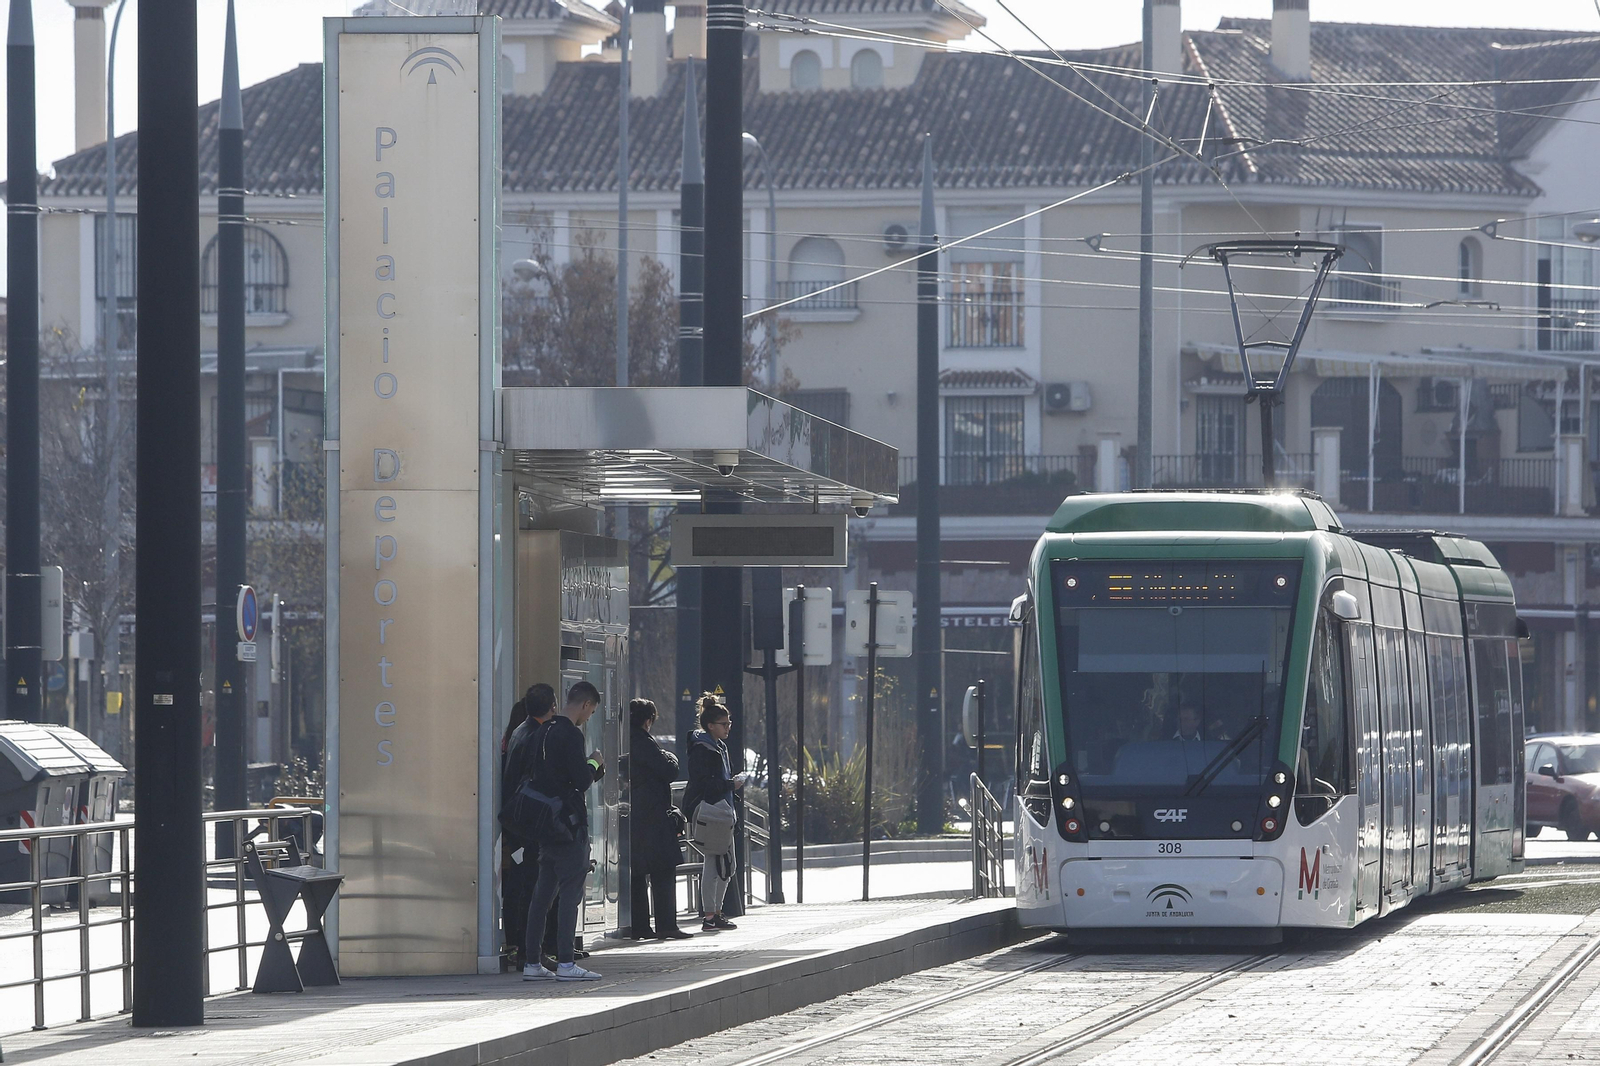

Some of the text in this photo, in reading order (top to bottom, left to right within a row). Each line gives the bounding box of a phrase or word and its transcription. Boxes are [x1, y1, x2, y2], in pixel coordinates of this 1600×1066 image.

[373, 126, 401, 766] Palacio Deportes
[1153, 808, 1188, 823] CAF
[1157, 842, 1183, 855] 308
[1297, 846, 1321, 901] M
